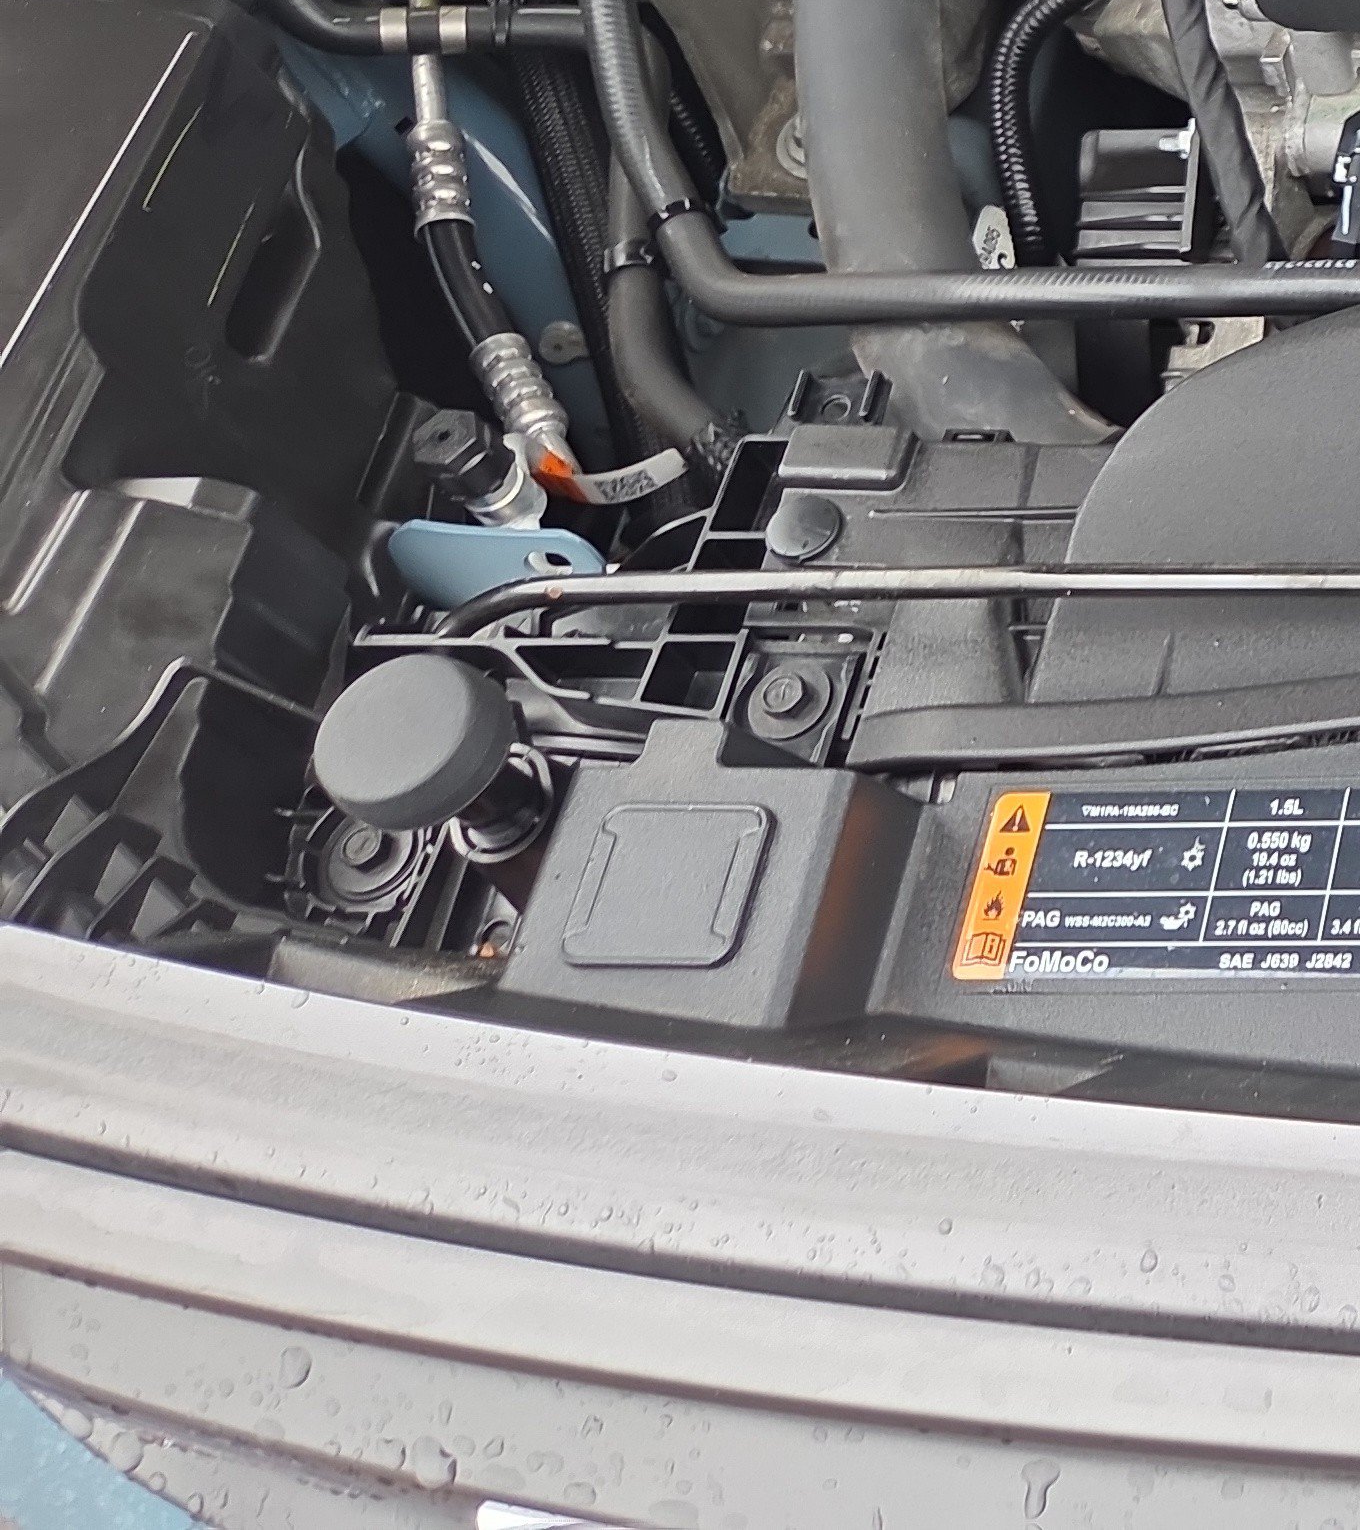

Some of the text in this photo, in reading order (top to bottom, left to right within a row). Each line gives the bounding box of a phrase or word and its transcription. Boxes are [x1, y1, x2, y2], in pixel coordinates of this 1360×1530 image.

[1270, 798, 1305, 816] 1.5L
[1246, 831, 1312, 852] 0.550 kg
[1072, 849, 1153, 871] R-1234yf
[1251, 852, 1298, 866] 19.4 oz
[1242, 869, 1303, 888] (1.21 lbs)
[1249, 900, 1282, 918] PAG
[1021, 910, 1061, 929] PAG
[1214, 919, 1309, 939] 2.7 fl oz (80cc)
[1330, 918, 1353, 935] 3.4
[1007, 949, 1111, 974] FoMoCo
[1218, 952, 1255, 969] SAE
[1260, 952, 1300, 969] J639
[1305, 952, 1353, 969] J2842
